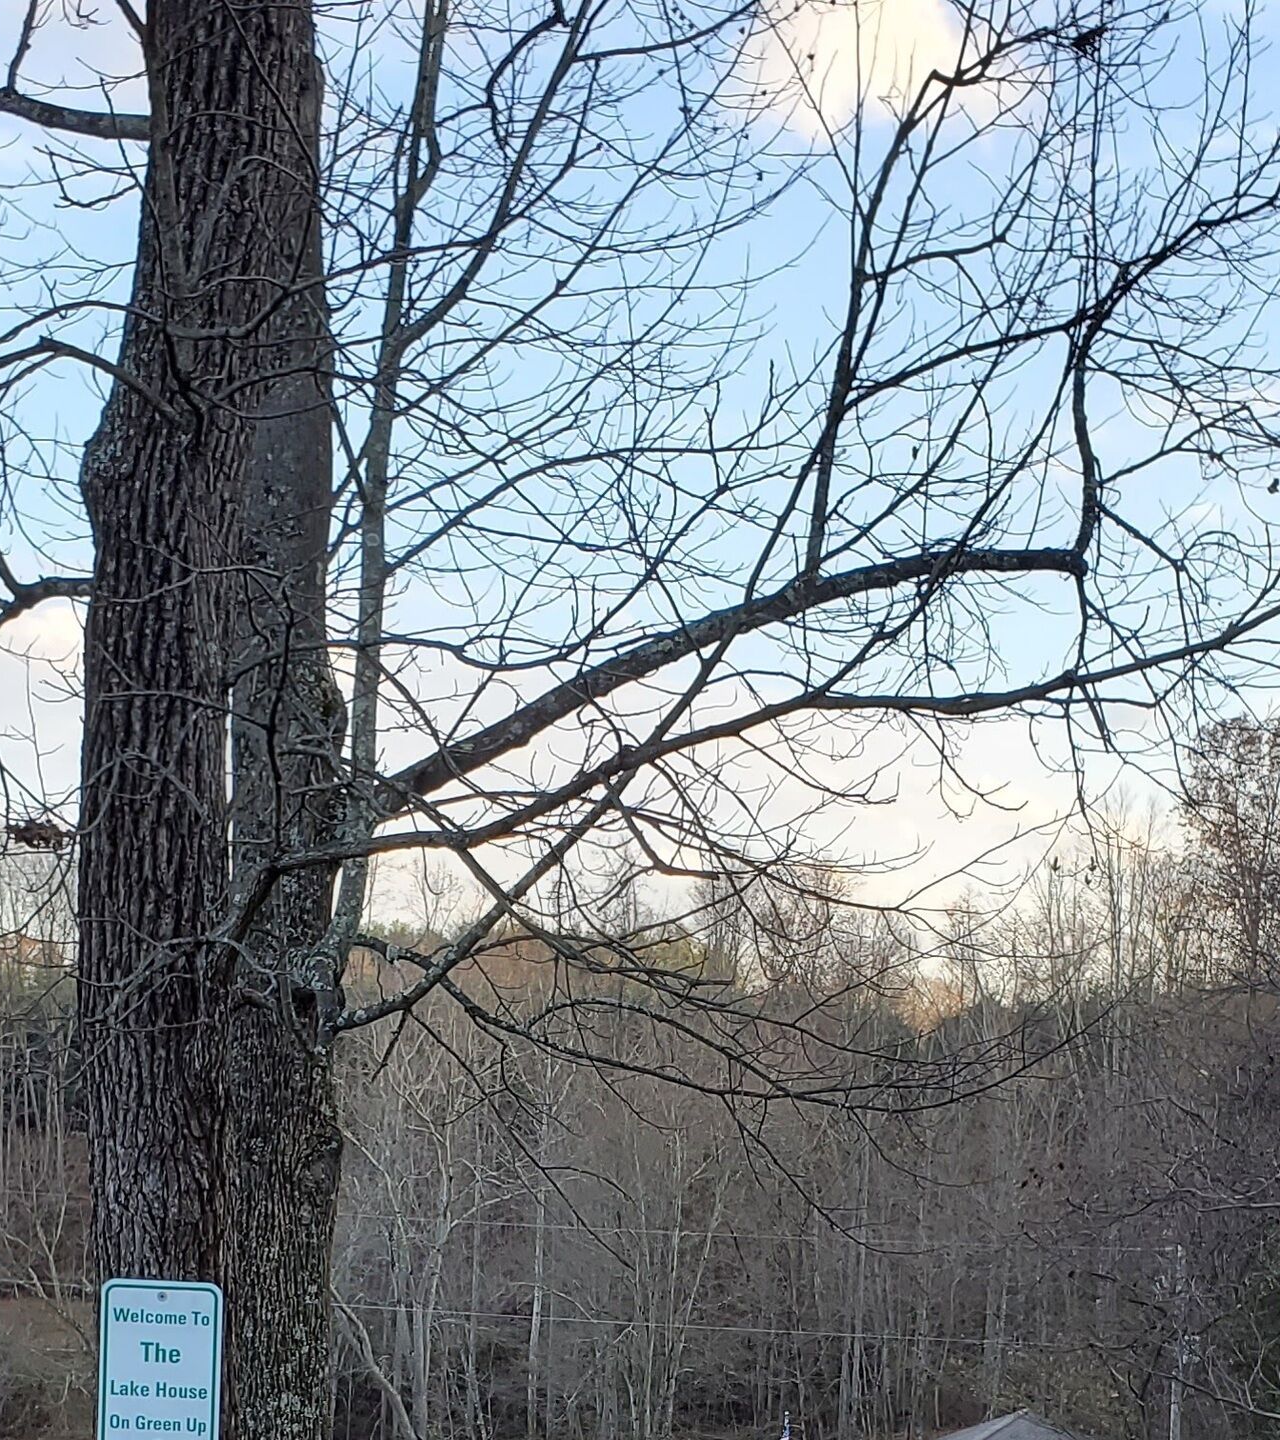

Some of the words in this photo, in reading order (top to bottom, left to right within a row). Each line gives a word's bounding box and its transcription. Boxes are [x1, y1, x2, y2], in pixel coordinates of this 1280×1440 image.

[113, 1307, 187, 1326] Welcome
[191, 1311, 210, 1327] To
[140, 1341, 181, 1364] The
[110, 1379, 150, 1398] Lake
[156, 1381, 208, 1400] House
[109, 1413, 130, 1430] On
[135, 1414, 181, 1432] Green
[186, 1417, 207, 1436] Up
